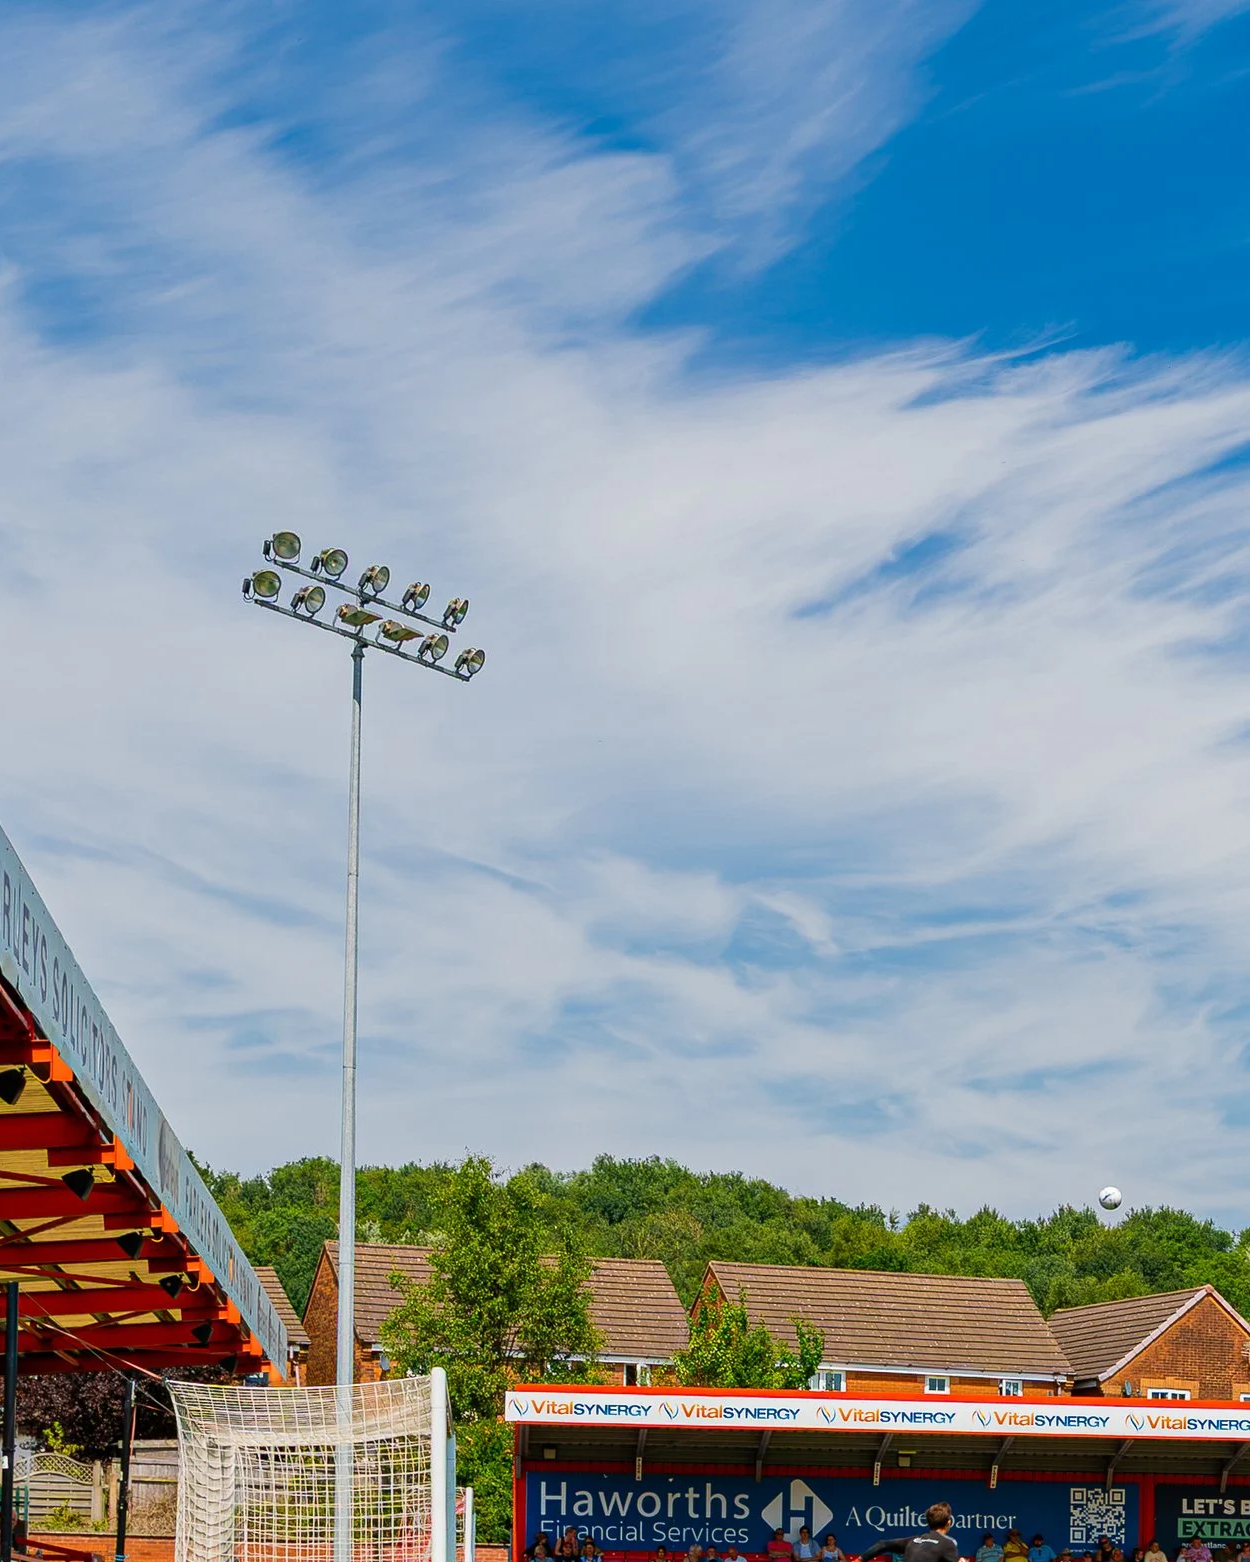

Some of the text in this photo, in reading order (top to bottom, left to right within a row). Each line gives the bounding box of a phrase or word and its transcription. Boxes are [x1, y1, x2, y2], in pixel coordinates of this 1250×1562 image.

[52, 956, 117, 1112] SOLICITORS
[531, 1400, 652, 1417] VitalSYNERGY
[682, 1403, 800, 1420] VitalSYNERGY
[838, 1408, 956, 1424] VitalSYNERGY
[994, 1411, 1110, 1428] VitalSYNERGY
[1147, 1415, 1250, 1431] VitalSYNERG
[540, 1481, 750, 1519] Haworths
[1182, 1498, 1235, 1515] LET'S
[846, 1507, 861, 1526] A
[865, 1505, 928, 1531] Quilte
[653, 1521, 749, 1543] Services
